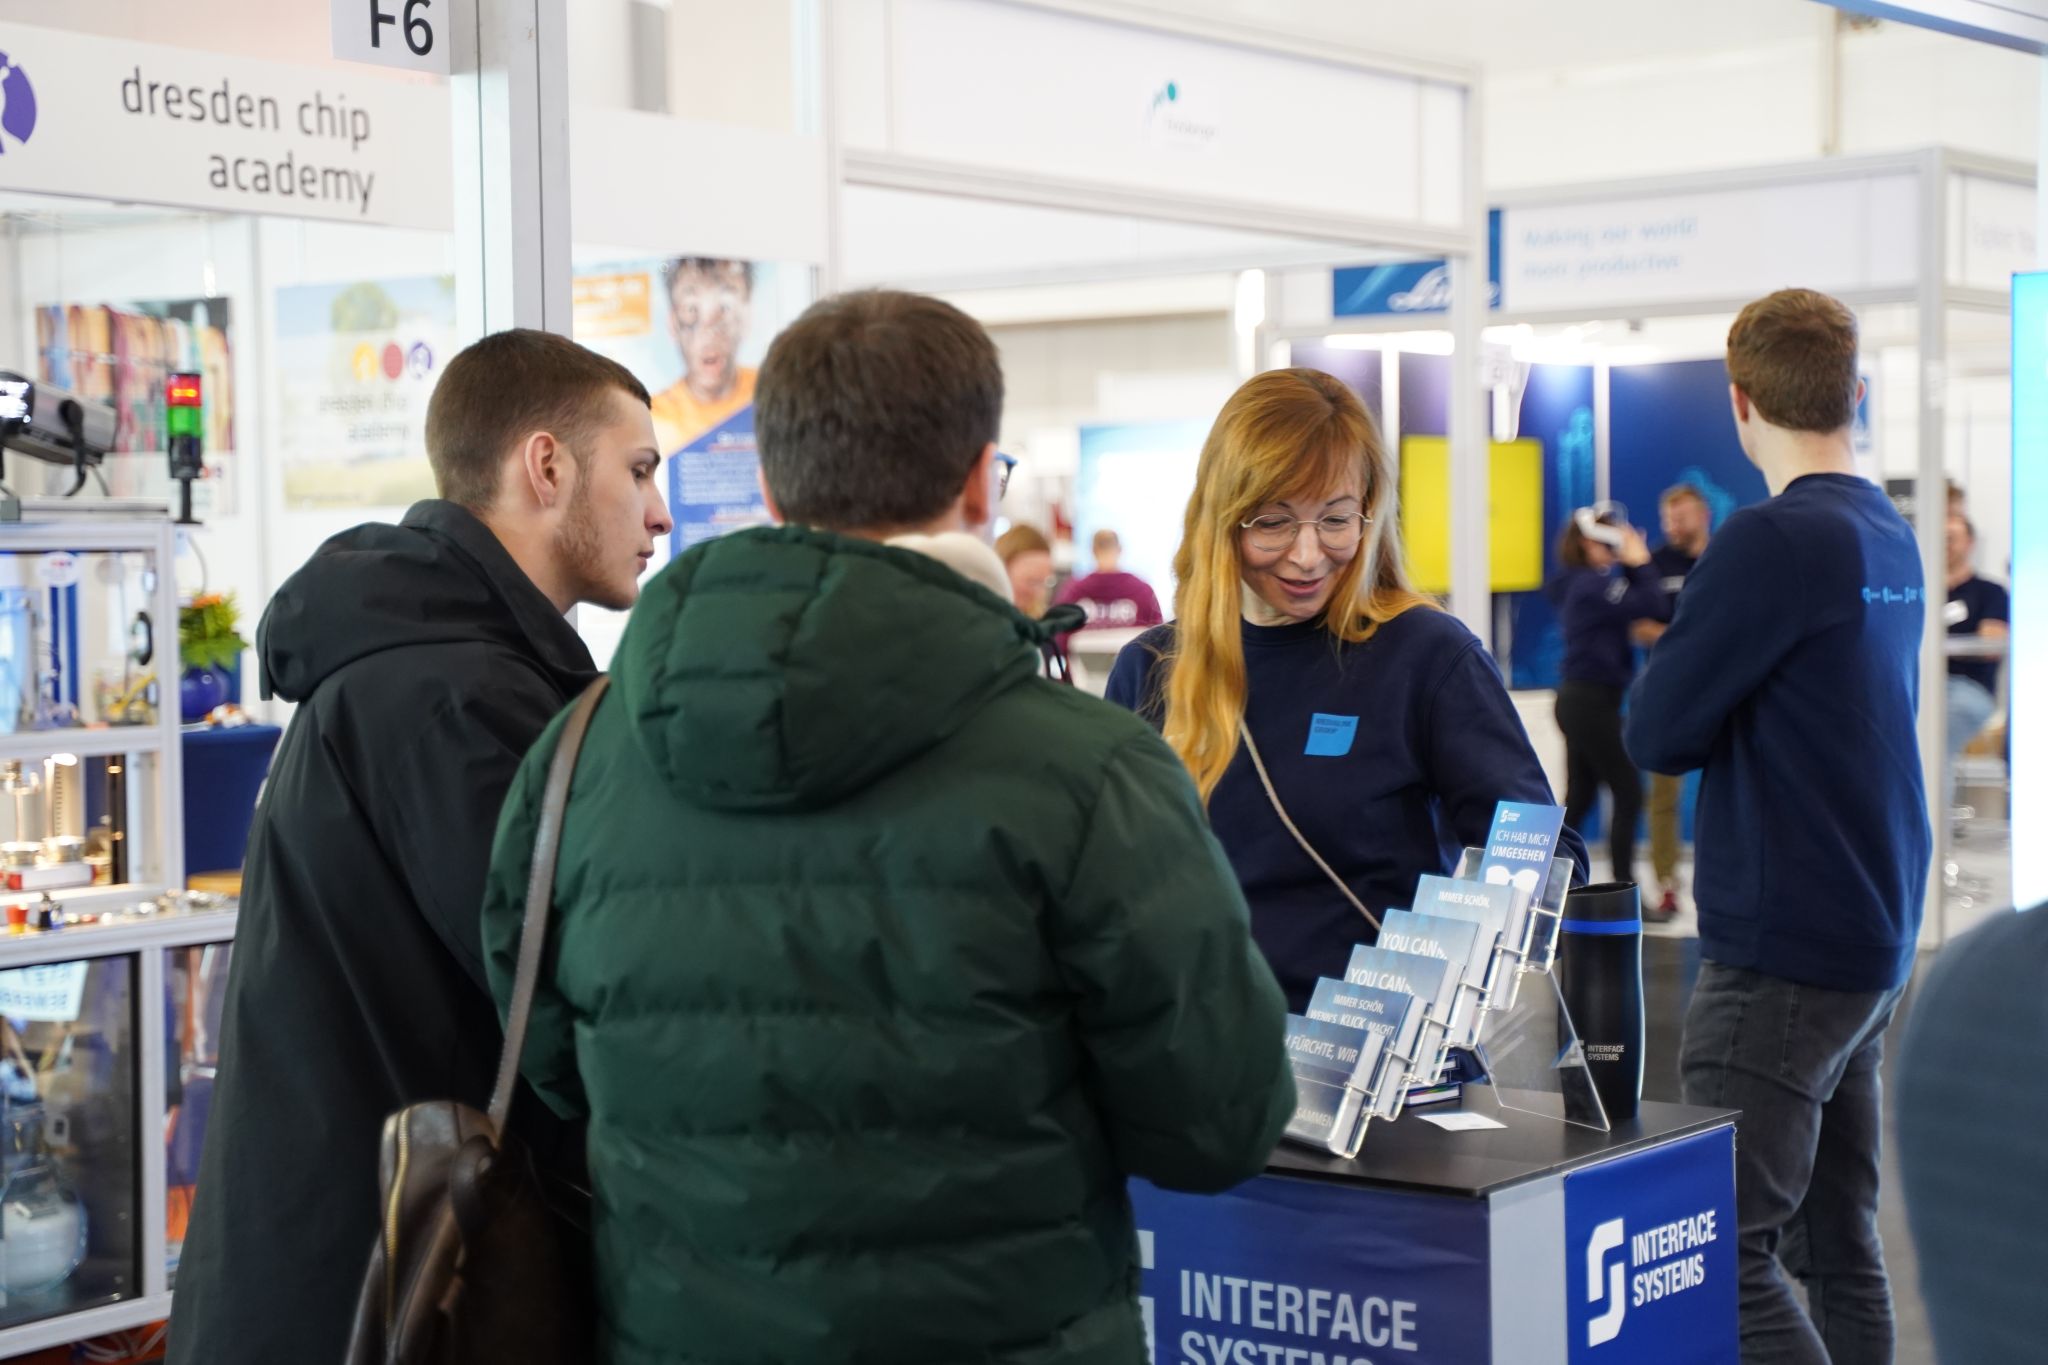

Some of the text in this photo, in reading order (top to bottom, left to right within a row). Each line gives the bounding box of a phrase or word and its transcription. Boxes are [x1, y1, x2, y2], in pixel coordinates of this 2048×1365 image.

[370, 0, 433, 56] F6
[122, 65, 371, 152] dresden chip
[209, 151, 375, 214] academy
[1495, 829, 1551, 847] ICH HAB MICH
[1491, 845, 1547, 864] UMGESEHEN
[1438, 891, 1463, 905] IMMER
[1382, 932, 1410, 952] YOU
[1350, 967, 1378, 987] YOU
[1333, 994, 1384, 1016] IMMER SCHÖN,
[1340, 1013, 1367, 1031] KLICK
[1368, 1020, 1395, 1037] MACHT
[1291, 1034, 1335, 1060] FÜRCHTE,
[1337, 1046, 1358, 1064] WIR
[1587, 1044, 1625, 1053] INTERFACE
[1587, 1053, 1620, 1061] SYSTEMS
[1295, 1107, 1334, 1127] SAMMEN
[1632, 1210, 1717, 1268] INTERFACE
[1633, 1253, 1705, 1308] SYSTEMS
[1180, 1269, 1418, 1352] INTERFACE
